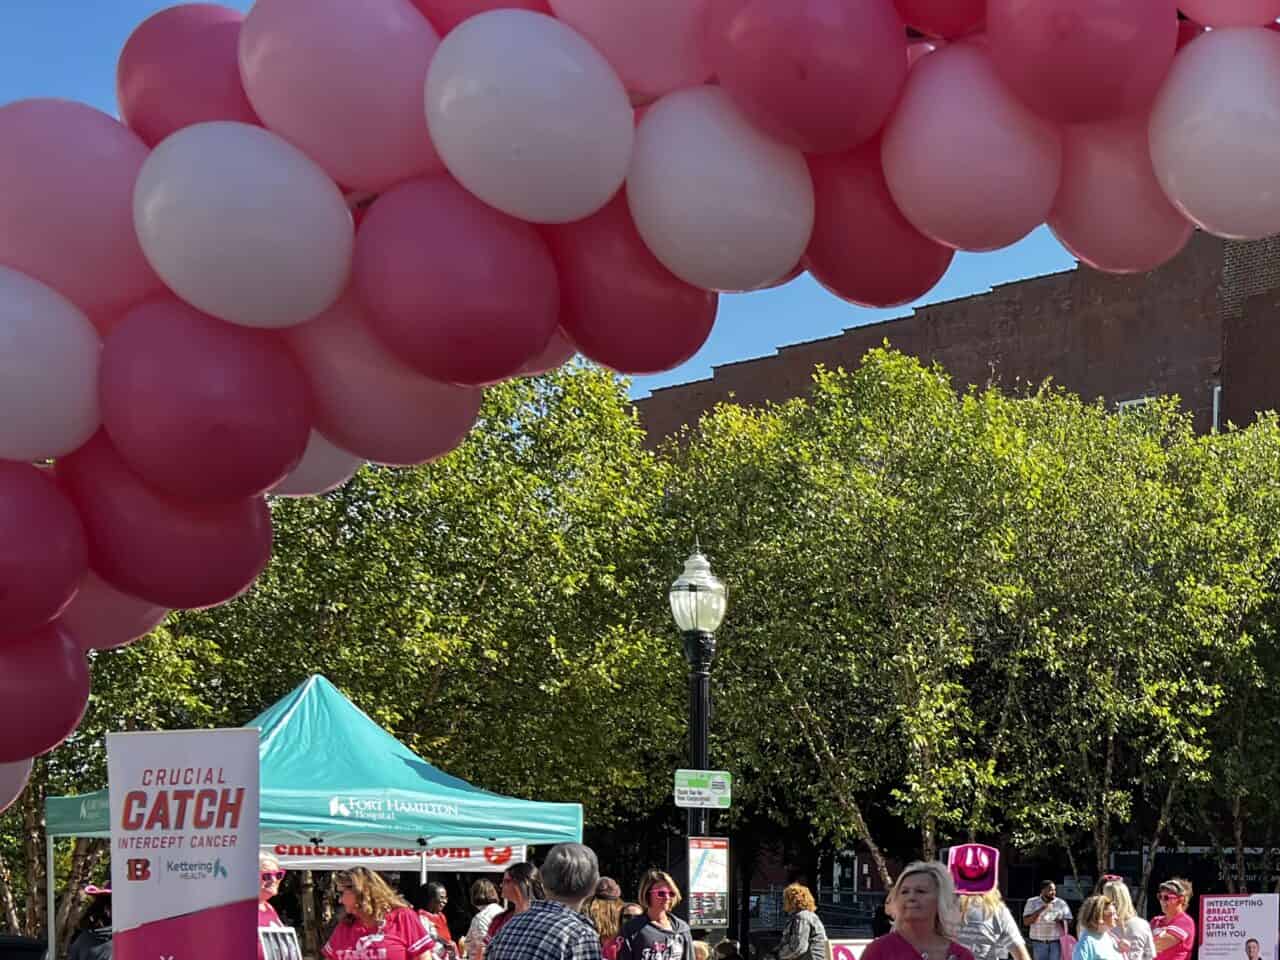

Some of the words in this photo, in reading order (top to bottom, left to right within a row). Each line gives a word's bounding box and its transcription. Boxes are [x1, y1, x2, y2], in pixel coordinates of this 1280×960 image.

[142, 768, 225, 786] CRUCIAL
[122, 788, 245, 831] CATCH
[118, 836, 184, 849] INTERCEPT
[191, 835, 238, 848] CANCER
[166, 860, 213, 873] Kettering
